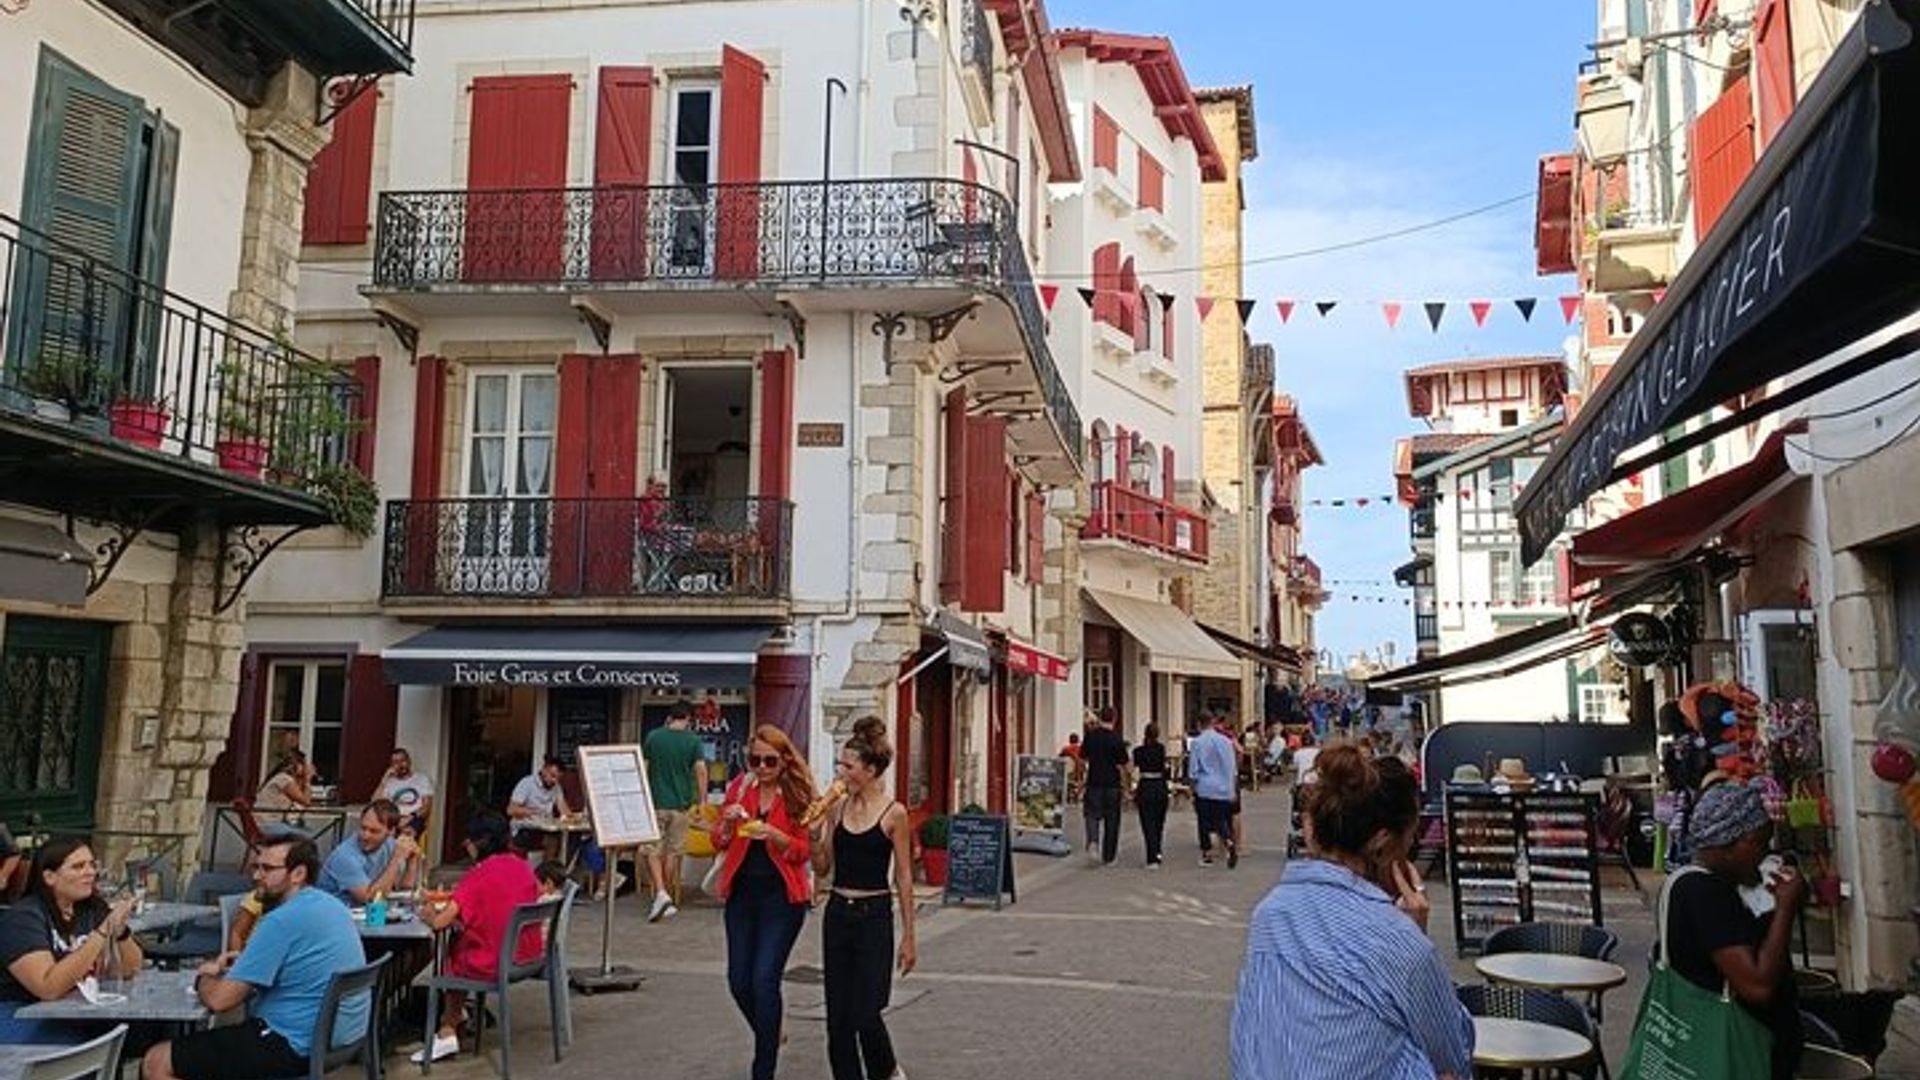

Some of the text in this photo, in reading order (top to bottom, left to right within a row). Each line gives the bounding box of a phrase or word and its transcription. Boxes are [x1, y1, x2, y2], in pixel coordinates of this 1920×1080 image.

[1658, 205, 1791, 406] GLACIER
[453, 662, 681, 687] Foie Gras et Conserves
